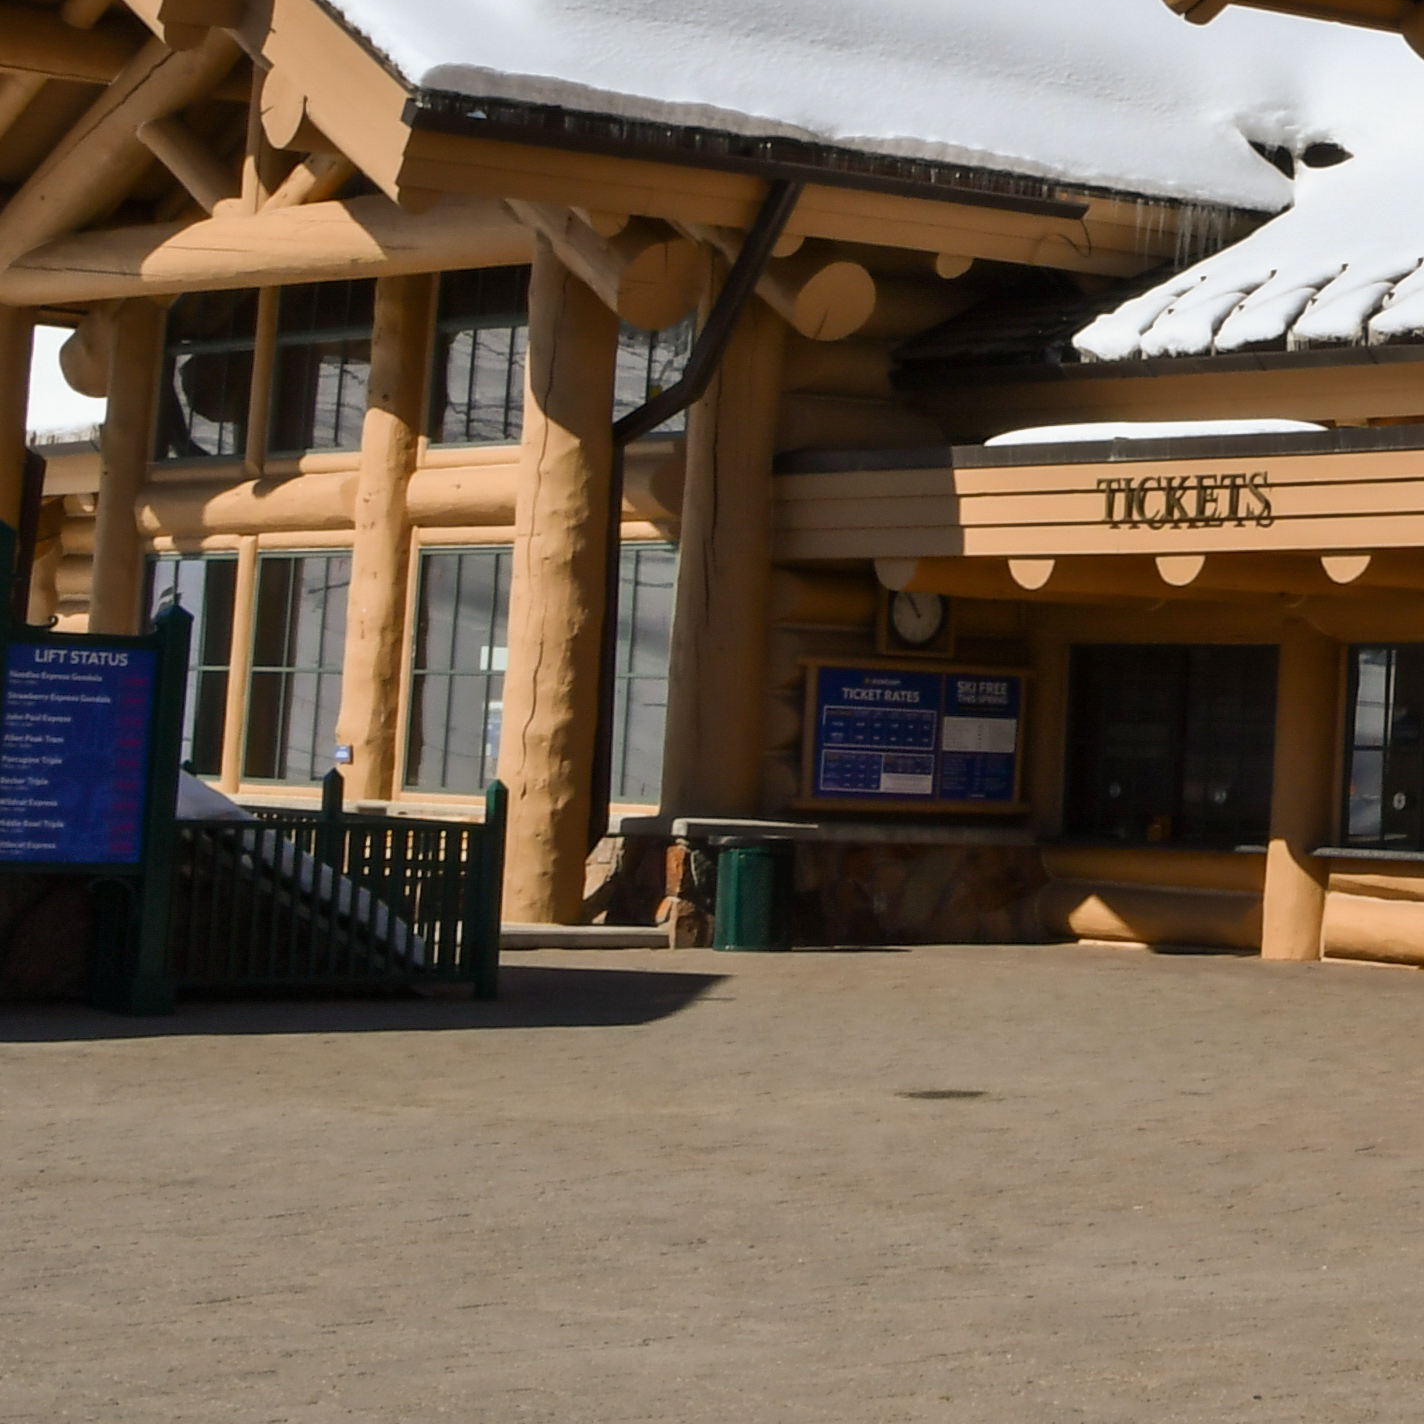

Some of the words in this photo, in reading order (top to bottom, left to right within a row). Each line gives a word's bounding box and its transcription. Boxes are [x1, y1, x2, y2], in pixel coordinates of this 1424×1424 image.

[1096, 470, 1273, 525] TICKETS
[34, 649, 68, 664] LIFT
[69, 650, 129, 667] STATUS
[841, 687, 883, 701] TICKET
[884, 689, 920, 703] RATES
[979, 682, 1009, 695] FREE
